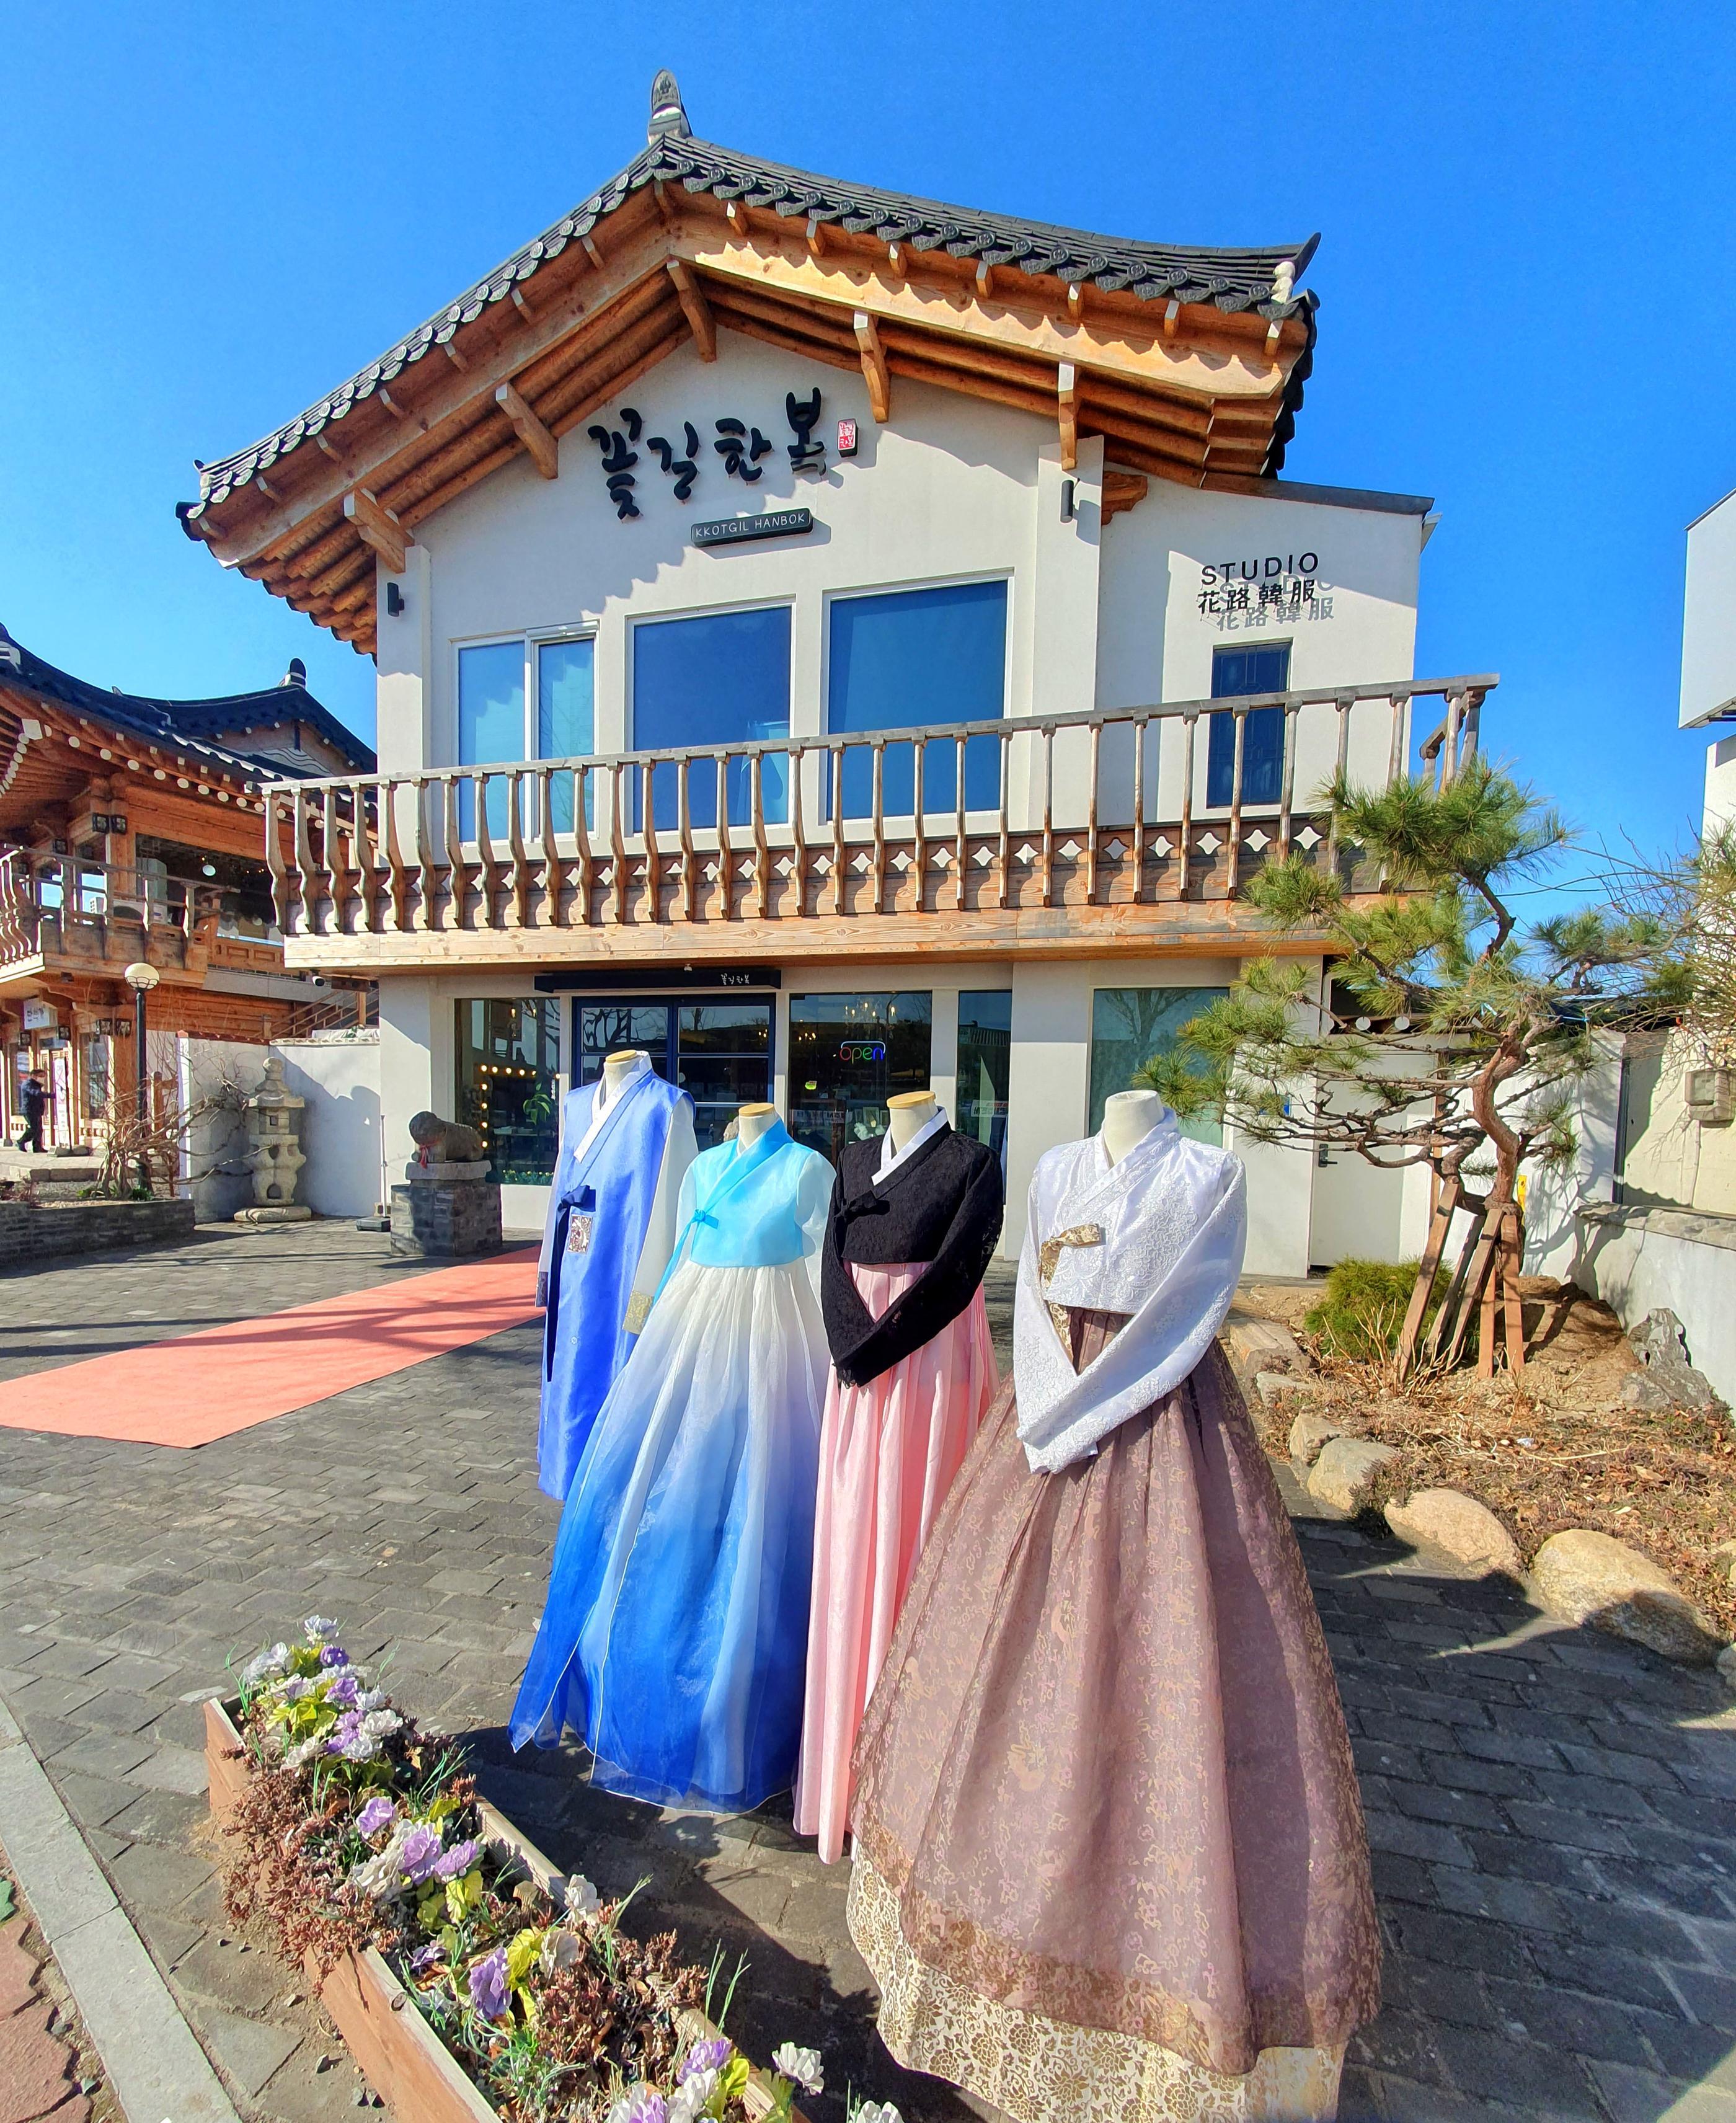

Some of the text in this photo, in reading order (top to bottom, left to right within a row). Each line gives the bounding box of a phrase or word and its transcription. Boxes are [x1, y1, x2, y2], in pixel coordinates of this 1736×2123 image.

[696, 513, 805, 538] KKOTGIL HANBOK
[1201, 552, 1319, 585] STUDIO
[1197, 578, 1315, 614] 花路韓服
[839, 1047, 883, 1064] open
